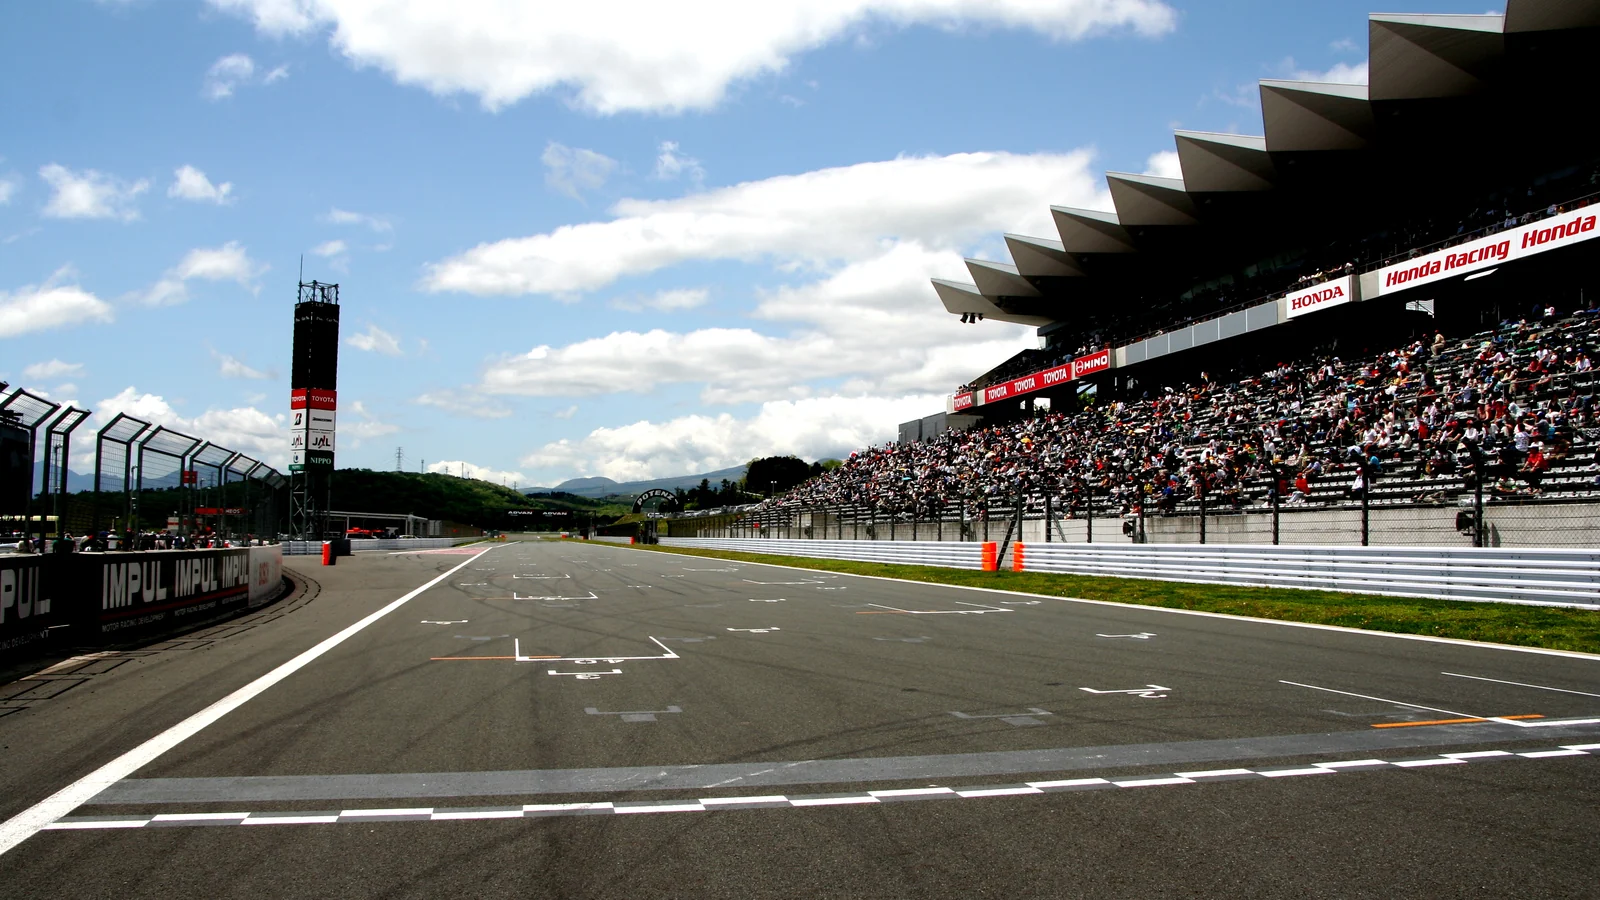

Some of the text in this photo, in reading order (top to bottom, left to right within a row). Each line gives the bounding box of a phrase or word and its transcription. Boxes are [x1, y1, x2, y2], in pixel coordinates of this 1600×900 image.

[1521, 215, 1597, 249] Honda
[1385, 240, 1511, 287] Honda Racing
[1291, 285, 1345, 310] HONDA
[1083, 355, 1108, 370] HINO
[1043, 368, 1067, 384] TOYOTA
[1014, 377, 1036, 392] TOYOTA
[311, 395, 335, 403] TOYOTA
[987, 385, 1008, 400] TOYOTA
[954, 395, 972, 409] TOYOTA
[312, 435, 331, 449] JAL
[310, 456, 332, 465] NIPPO
[175, 557, 218, 598] IMPUL
[222, 554, 248, 589] IMPUL
[102, 560, 167, 610] IMPUL
[101, 621, 120, 633] MOTOR
[120, 618, 137, 629] RACING
[0, 639, 11, 650] ING
